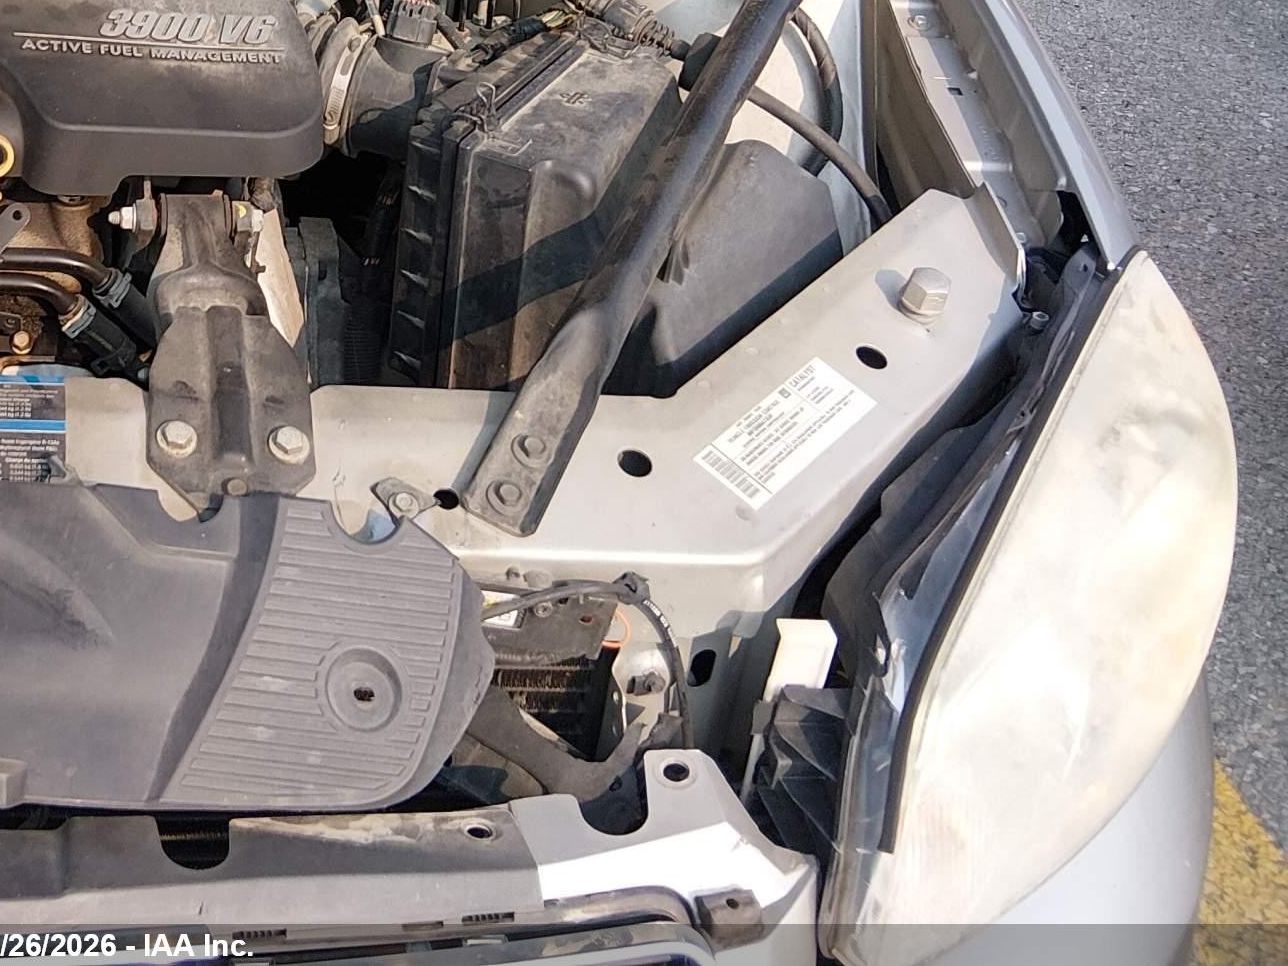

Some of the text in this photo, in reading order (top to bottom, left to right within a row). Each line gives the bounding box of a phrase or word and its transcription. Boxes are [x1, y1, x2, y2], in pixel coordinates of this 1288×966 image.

[100, 9, 277, 45] 3900 V6
[21, 38, 282, 65] ACTIVE FUEL MANAGEMENT
